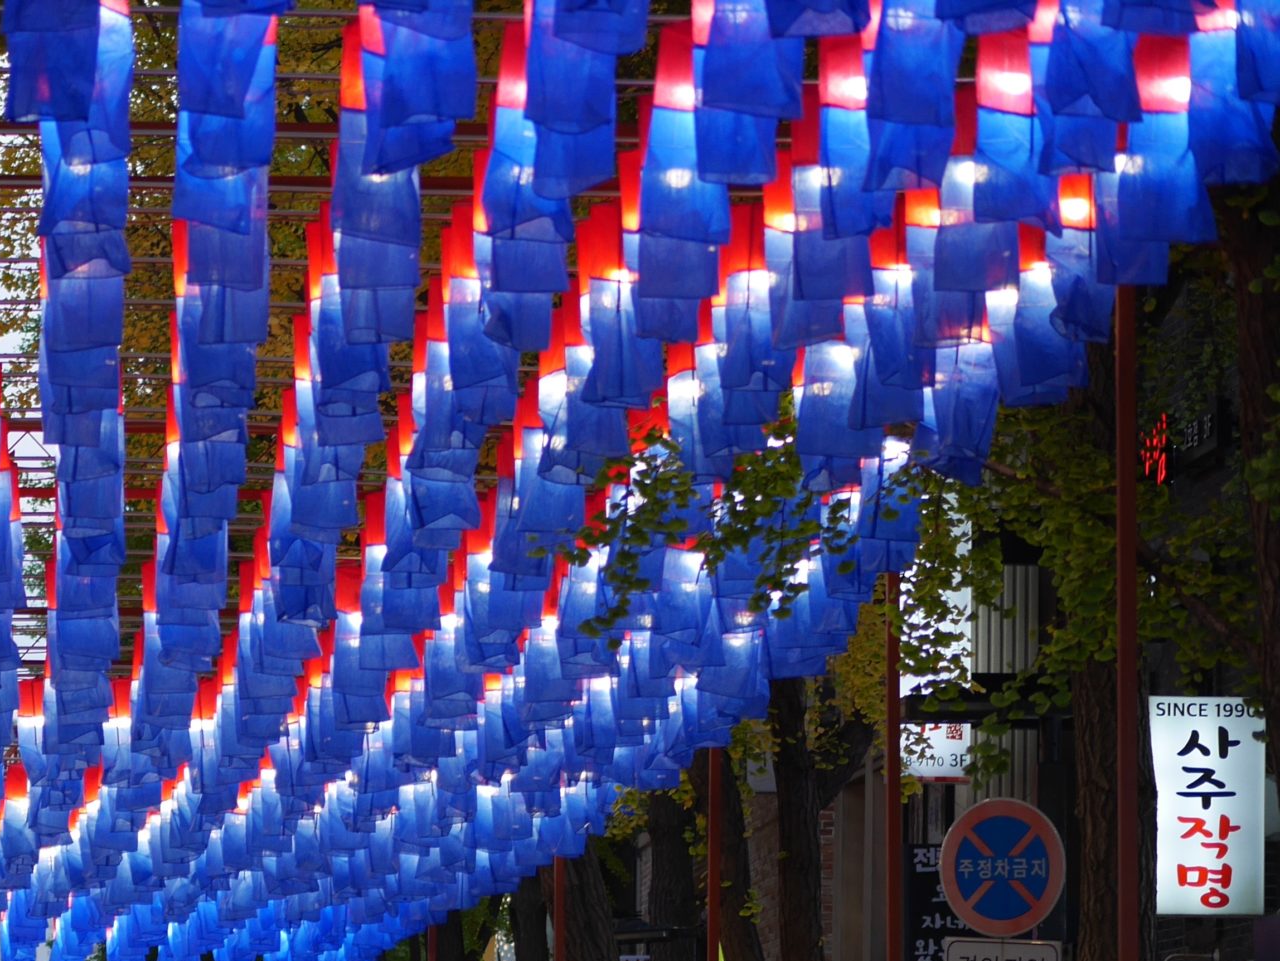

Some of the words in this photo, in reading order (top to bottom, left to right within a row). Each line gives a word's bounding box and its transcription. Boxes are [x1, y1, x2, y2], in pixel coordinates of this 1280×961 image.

[1156, 702, 1208, 717] SINCE
[950, 753, 968, 767] 3F
[958, 857, 1047, 879] 주정차금지
